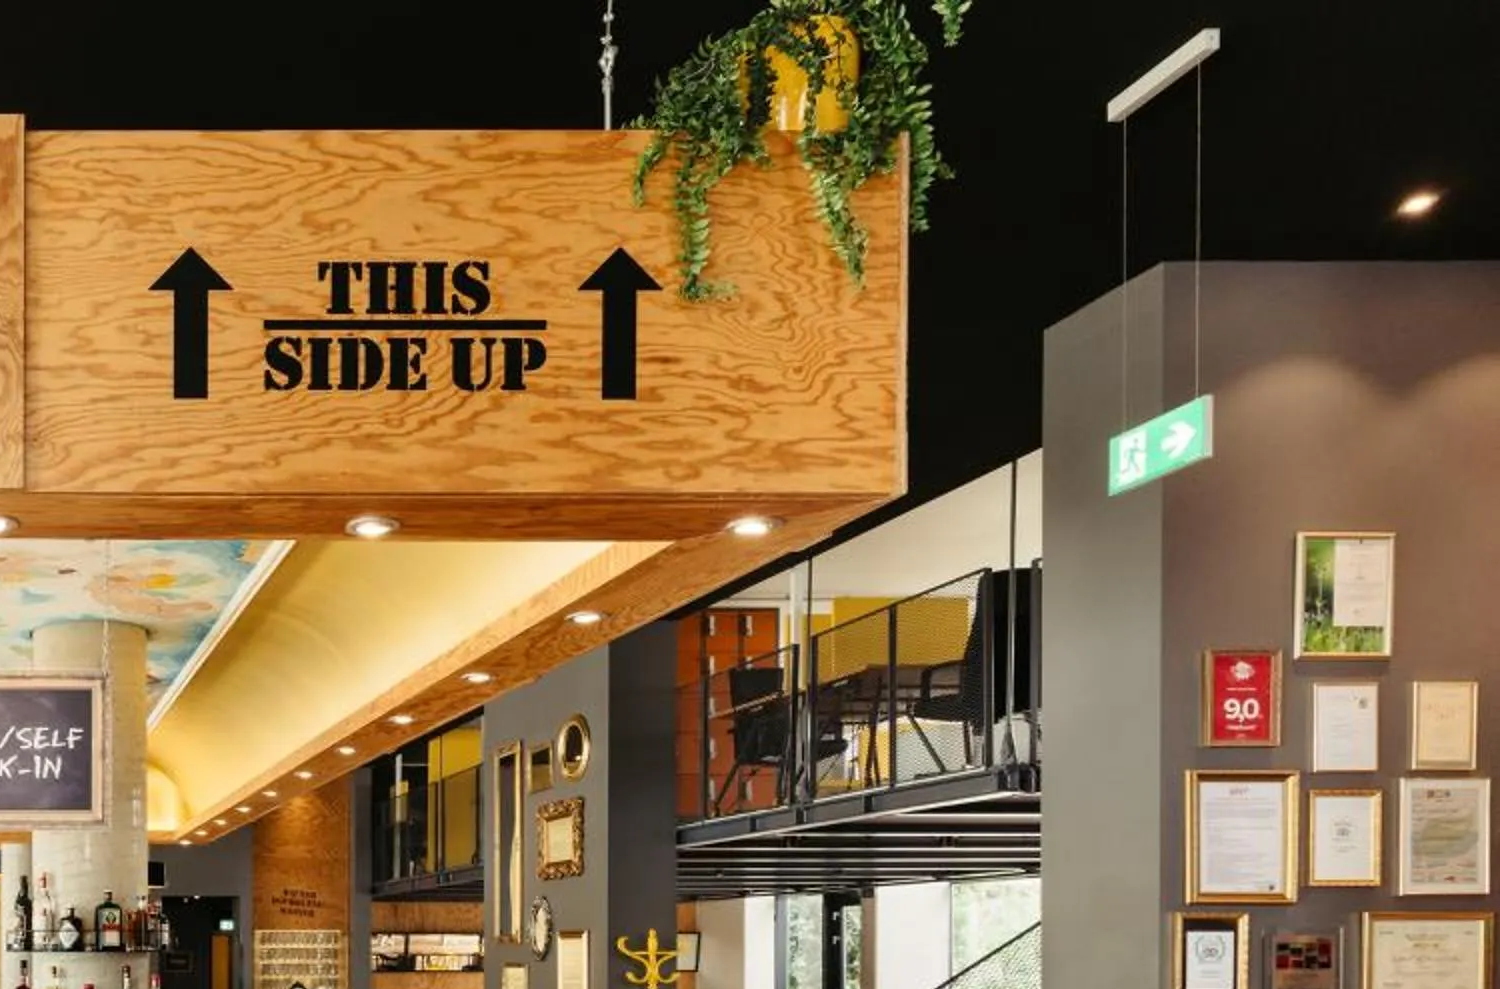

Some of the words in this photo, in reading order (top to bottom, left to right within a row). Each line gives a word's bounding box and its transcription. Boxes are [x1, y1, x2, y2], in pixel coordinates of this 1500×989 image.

[318, 261, 490, 315] THIS
[264, 337, 427, 391] SIDE
[449, 338, 546, 392] UP
